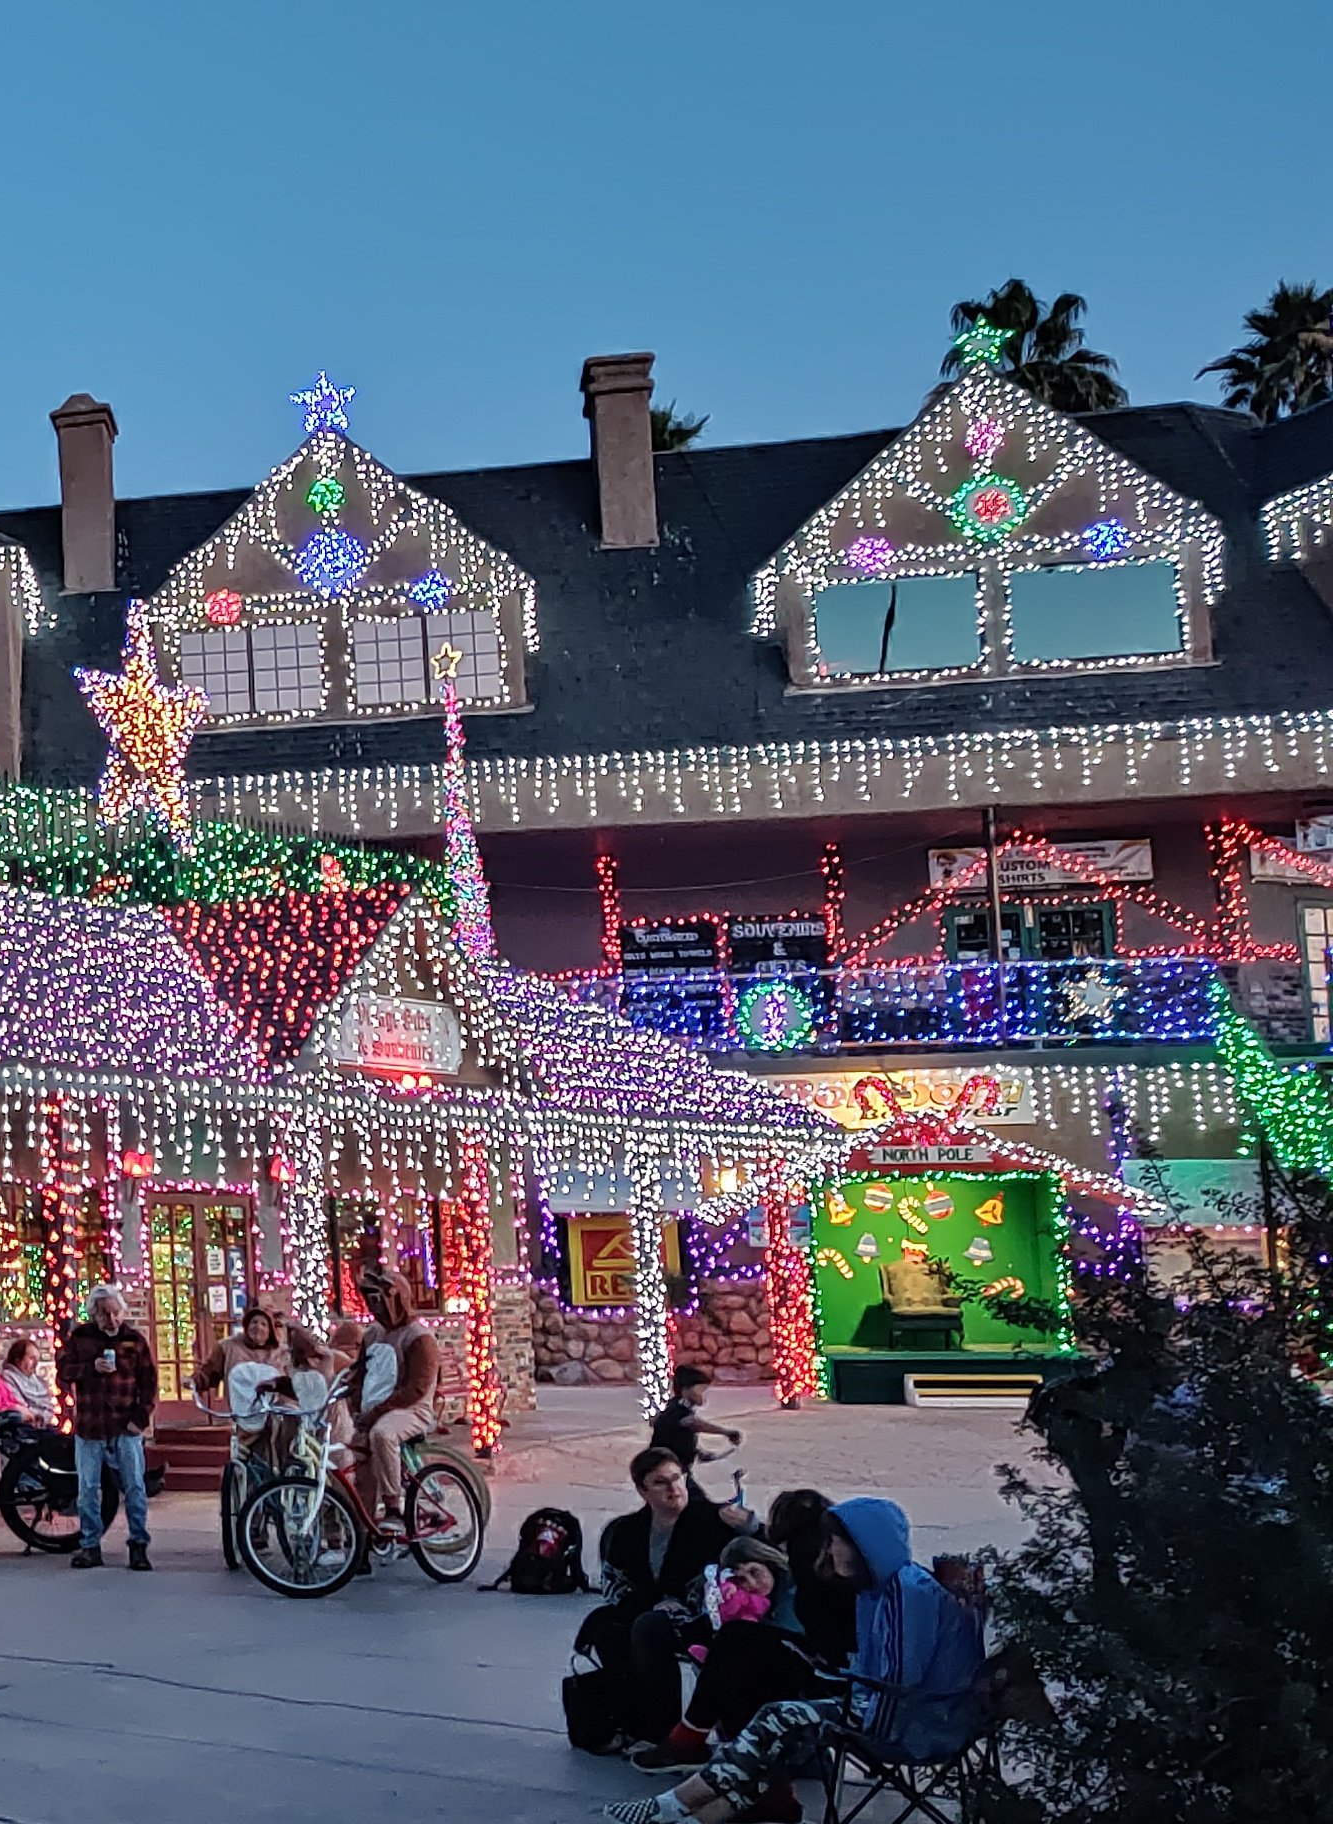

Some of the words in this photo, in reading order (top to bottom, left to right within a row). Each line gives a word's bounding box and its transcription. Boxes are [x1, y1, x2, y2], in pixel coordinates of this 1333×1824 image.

[996, 858, 1051, 872] USTOM
[733, 921, 826, 939] SOUVENIRS
[773, 942, 788, 956] &
[358, 1001, 398, 1033] Viage
[882, 1148, 928, 1162] NORTH
[938, 1147, 974, 1161] POLE
